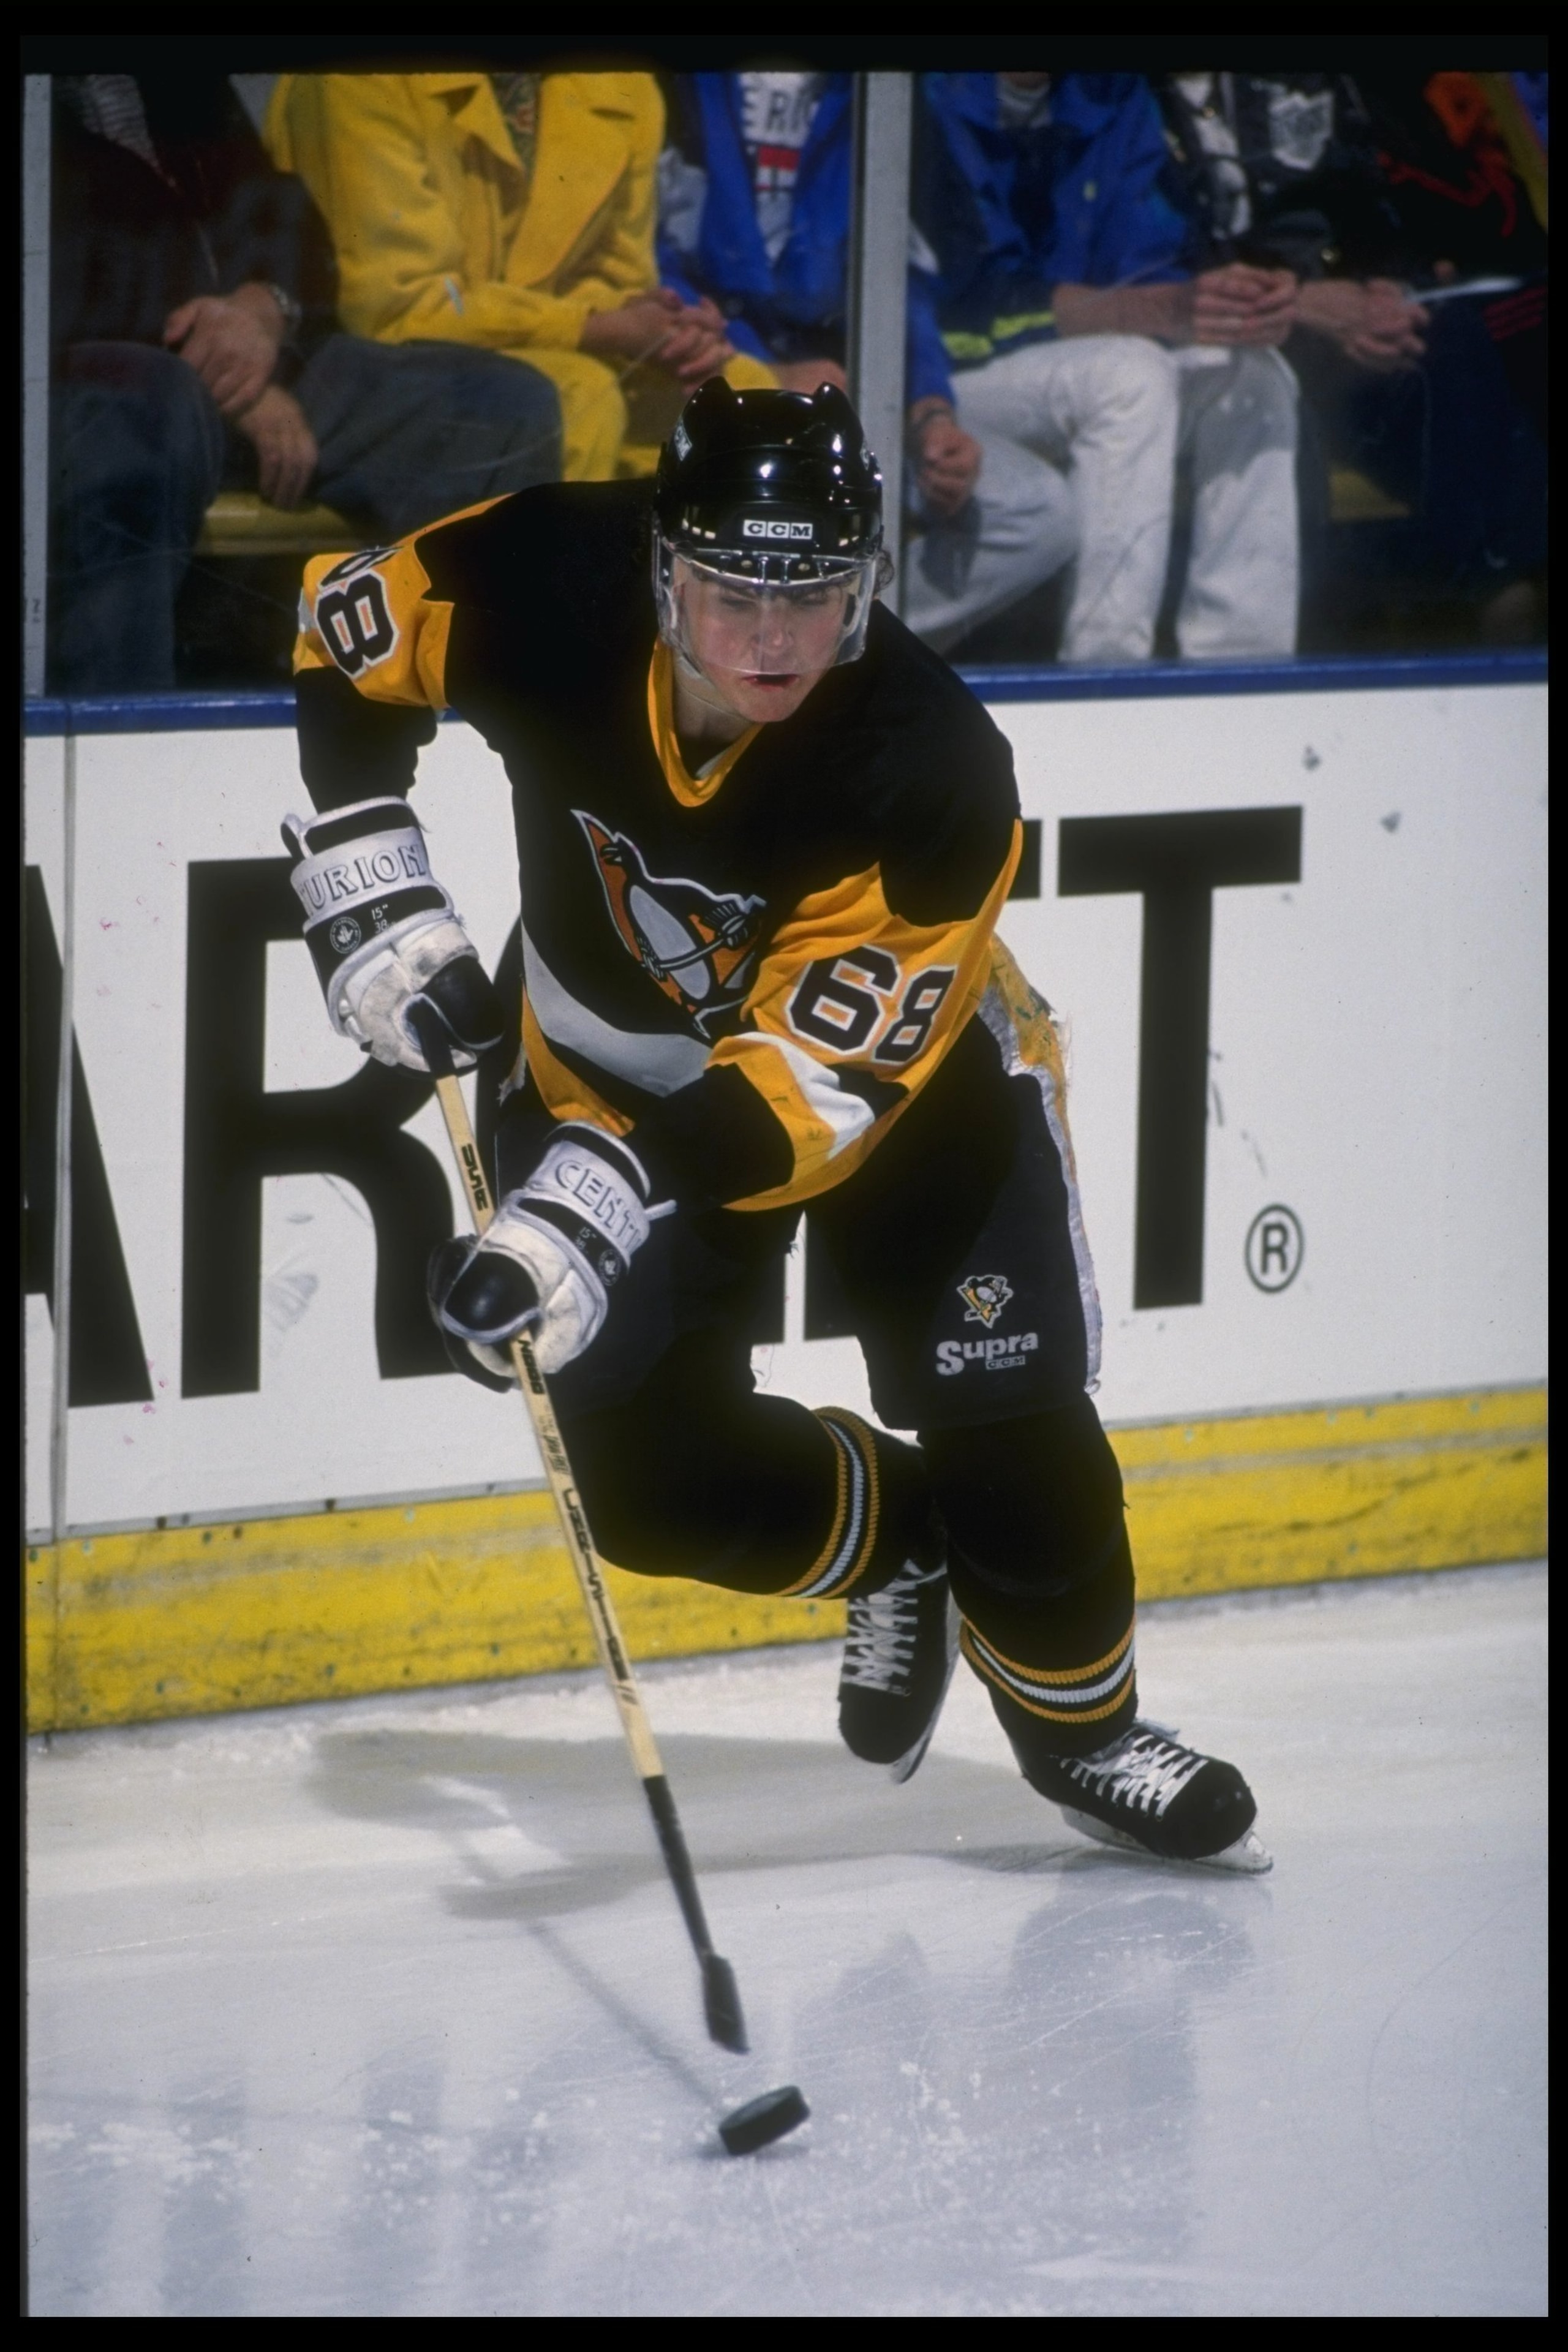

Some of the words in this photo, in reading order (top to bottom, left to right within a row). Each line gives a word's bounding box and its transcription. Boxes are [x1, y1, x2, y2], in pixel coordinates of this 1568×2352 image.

[745, 521, 813, 538] CCM
[785, 944, 959, 1066] 68
[935, 1332, 1039, 1376] Supra
[986, 1355, 1026, 1370] CCM
